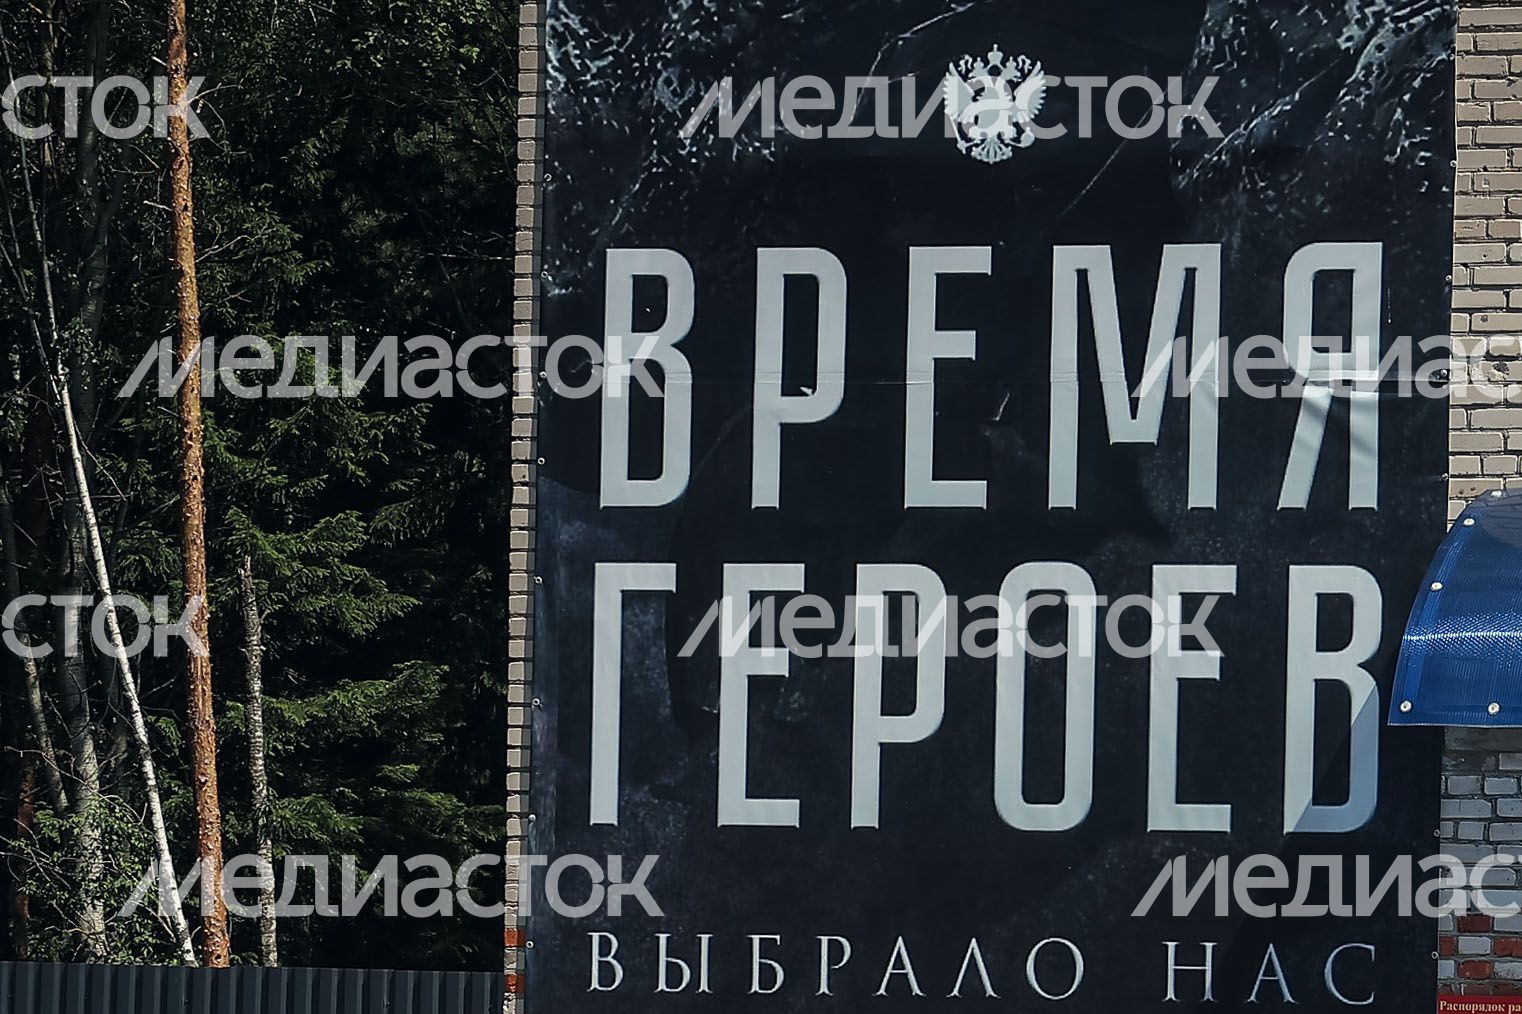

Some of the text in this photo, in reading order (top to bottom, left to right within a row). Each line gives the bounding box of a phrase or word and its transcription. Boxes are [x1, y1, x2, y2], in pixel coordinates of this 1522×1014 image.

[599, 242, 1384, 510] ВРЕМЯ
[589, 561, 1384, 835] ГЕРОЕВ
[586, 931, 1377, 1005] ВЫБРАЛО НАС
[1439, 1000, 1505, 1014] Распорядок
